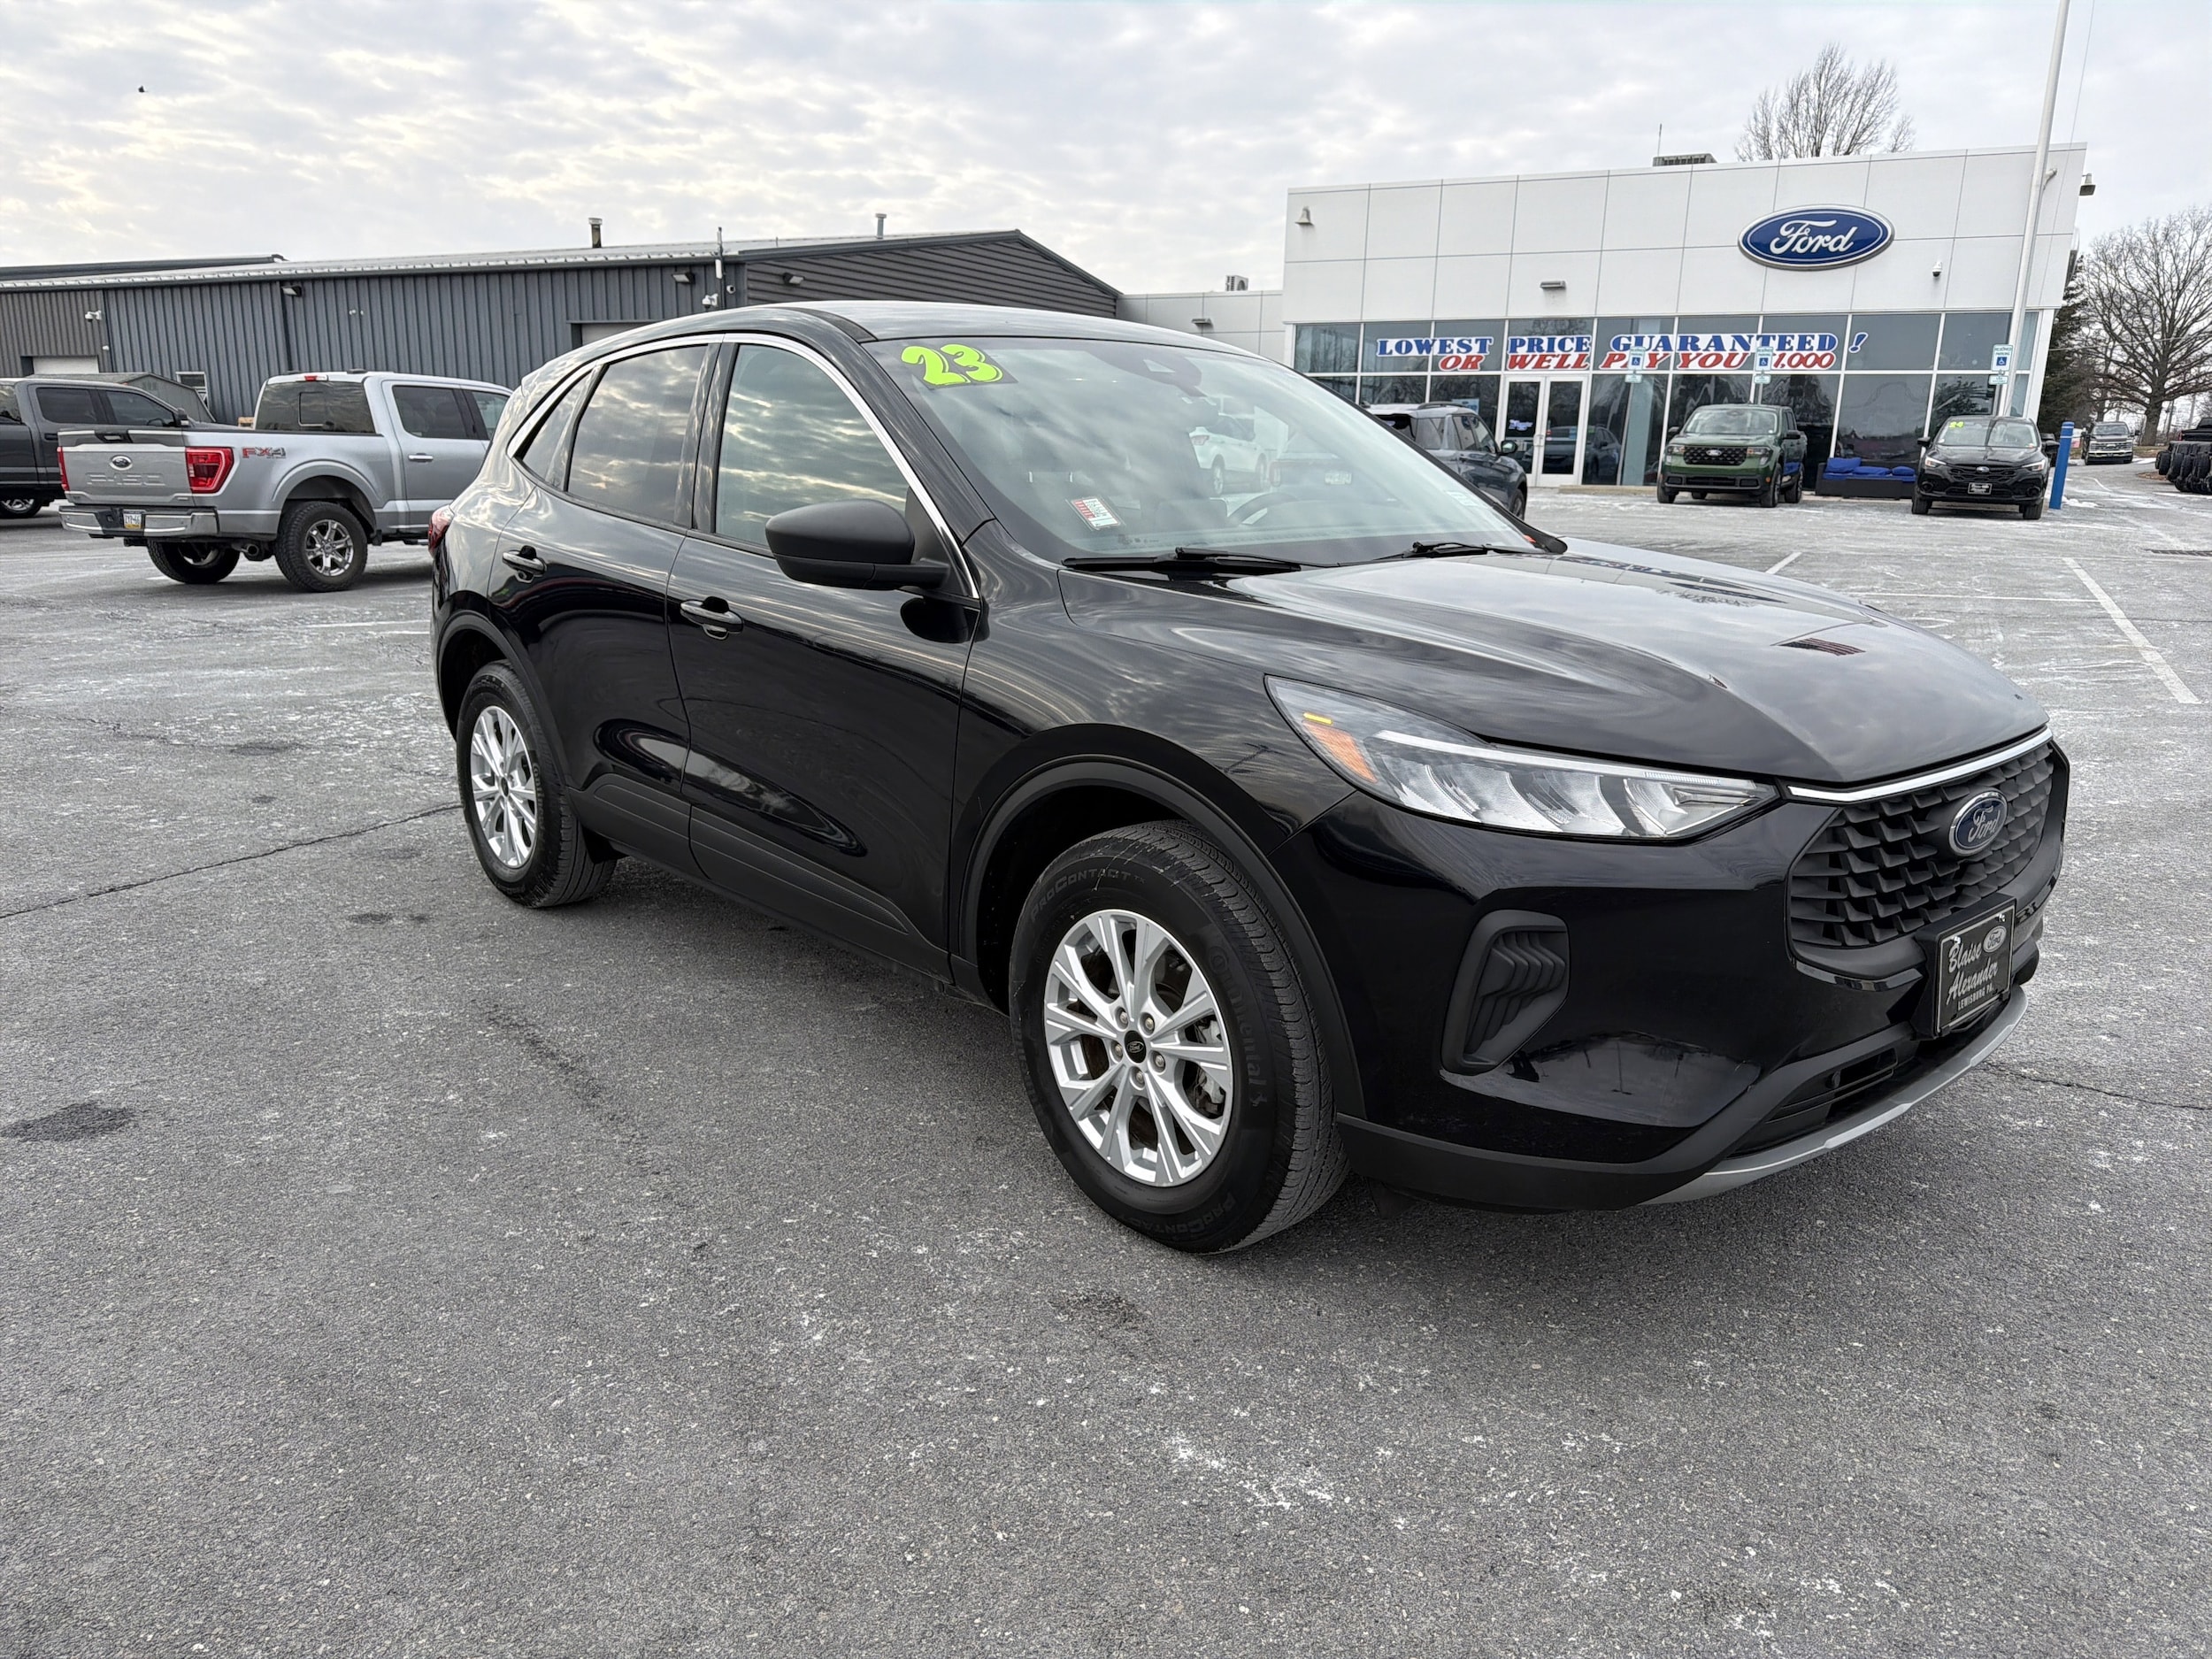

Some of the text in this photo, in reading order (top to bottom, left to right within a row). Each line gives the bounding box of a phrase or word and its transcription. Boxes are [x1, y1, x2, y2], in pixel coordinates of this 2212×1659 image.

[1770, 219, 1858, 255] Ford
[1378, 338, 1492, 356] LOWEST
[1509, 335, 1591, 354] PRICE
[1611, 333, 1838, 352] GUARANTEED
[901, 342, 1003, 386] 23
[1440, 354, 1485, 371] OR
[1601, 352, 1671, 368] PY
[1678, 351, 1751, 368] YOU
[242, 447, 286, 458] FX4
[85, 472, 166, 486] F-150
[1967, 804, 2001, 843] Ford
[1948, 942, 1982, 973] Blaise
[1946, 956, 1998, 1005] Alexander
[1957, 987, 1985, 1010] LEWISBURG
